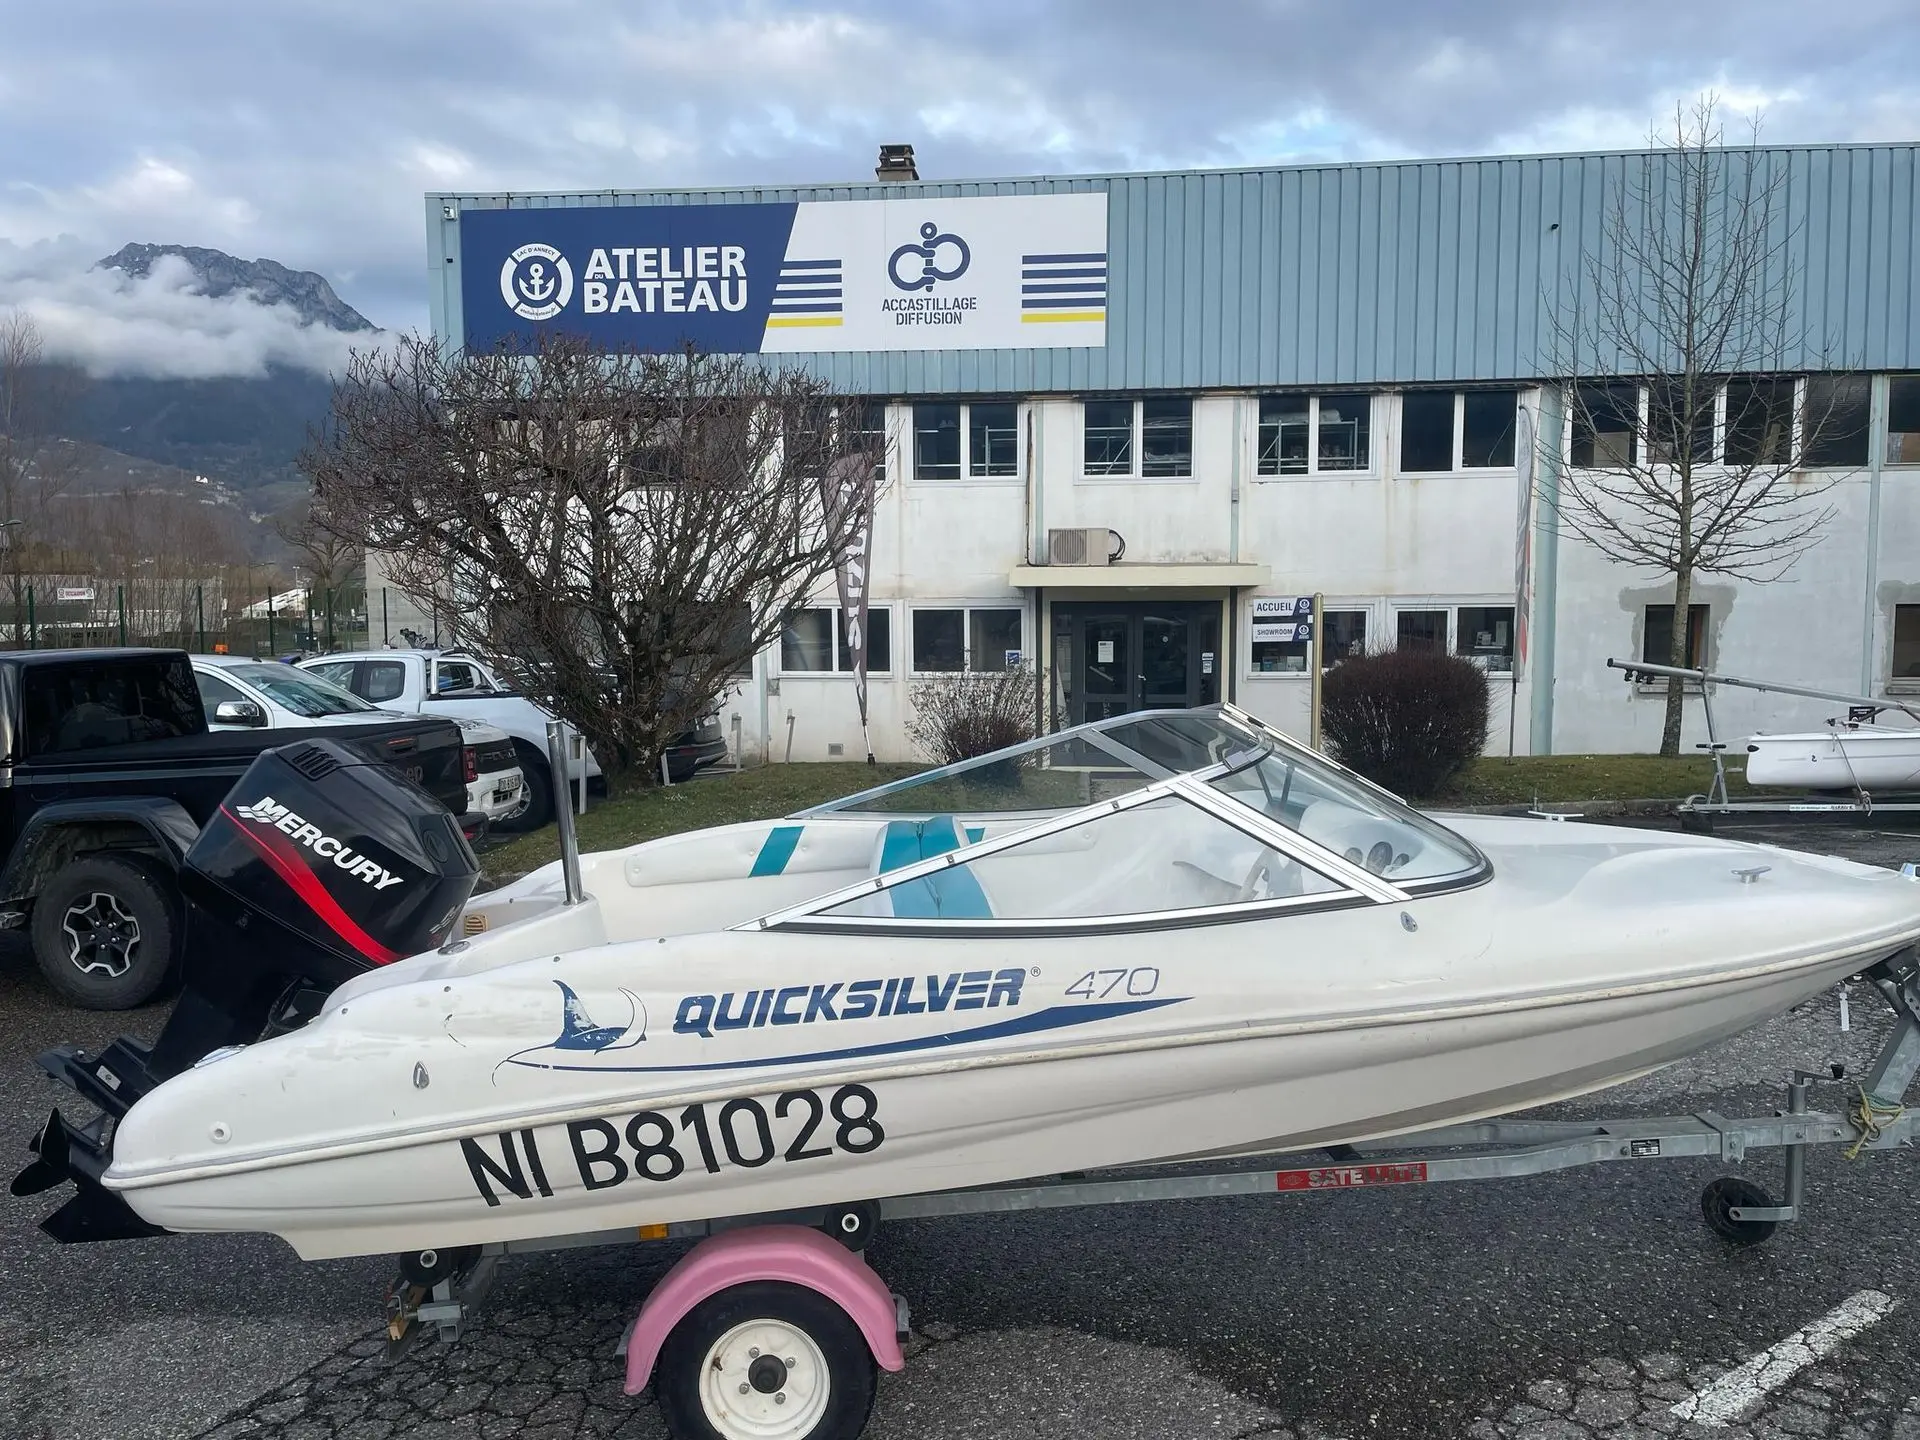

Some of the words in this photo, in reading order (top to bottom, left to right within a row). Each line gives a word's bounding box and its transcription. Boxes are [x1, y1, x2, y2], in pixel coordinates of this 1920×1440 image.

[516, 249, 527, 258] LAC
[528, 246, 555, 256] D'ANNECY
[584, 246, 747, 280] ATELIER
[584, 279, 748, 314] BATEAU
[881, 296, 977, 312] ACCASTILLAGE
[896, 311, 962, 326] DIFFUSION
[1256, 602, 1293, 611] ACCUEIL
[250, 796, 404, 891] MERCURY
[1064, 966, 1160, 1000] 470
[459, 1127, 555, 1208] NI
[565, 1083, 885, 1192] B81028
